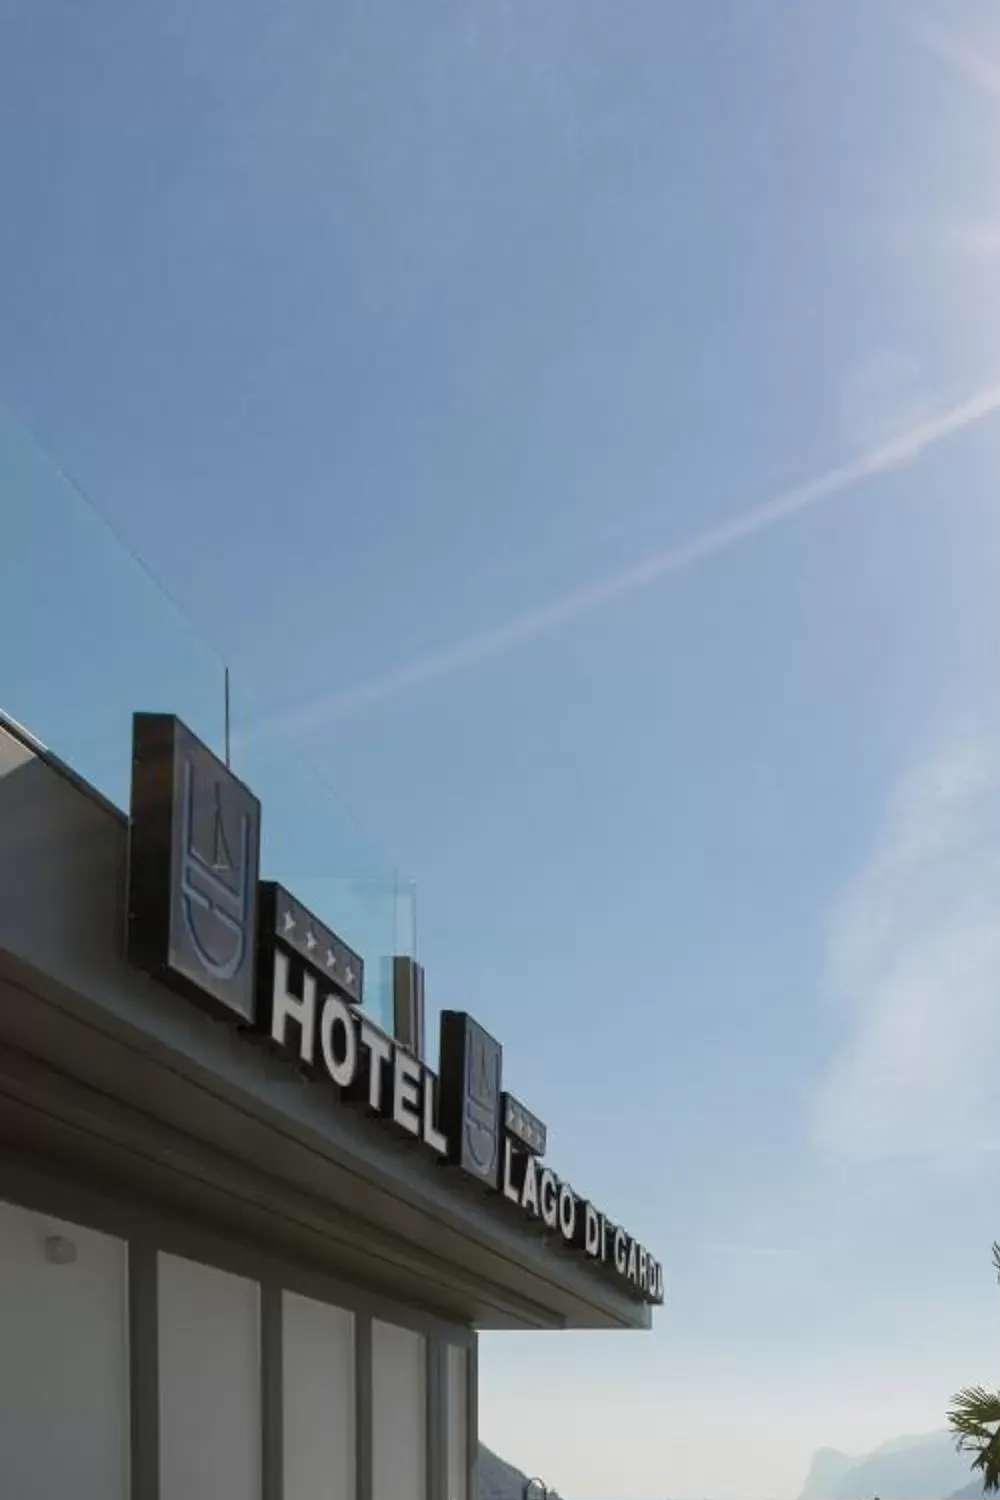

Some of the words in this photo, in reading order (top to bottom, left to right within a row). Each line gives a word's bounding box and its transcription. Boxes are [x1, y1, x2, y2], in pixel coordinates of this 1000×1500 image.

[271, 947, 448, 1156] HOTEL
[503, 1135, 576, 1240] LAGO
[585, 1201, 606, 1261] DI
